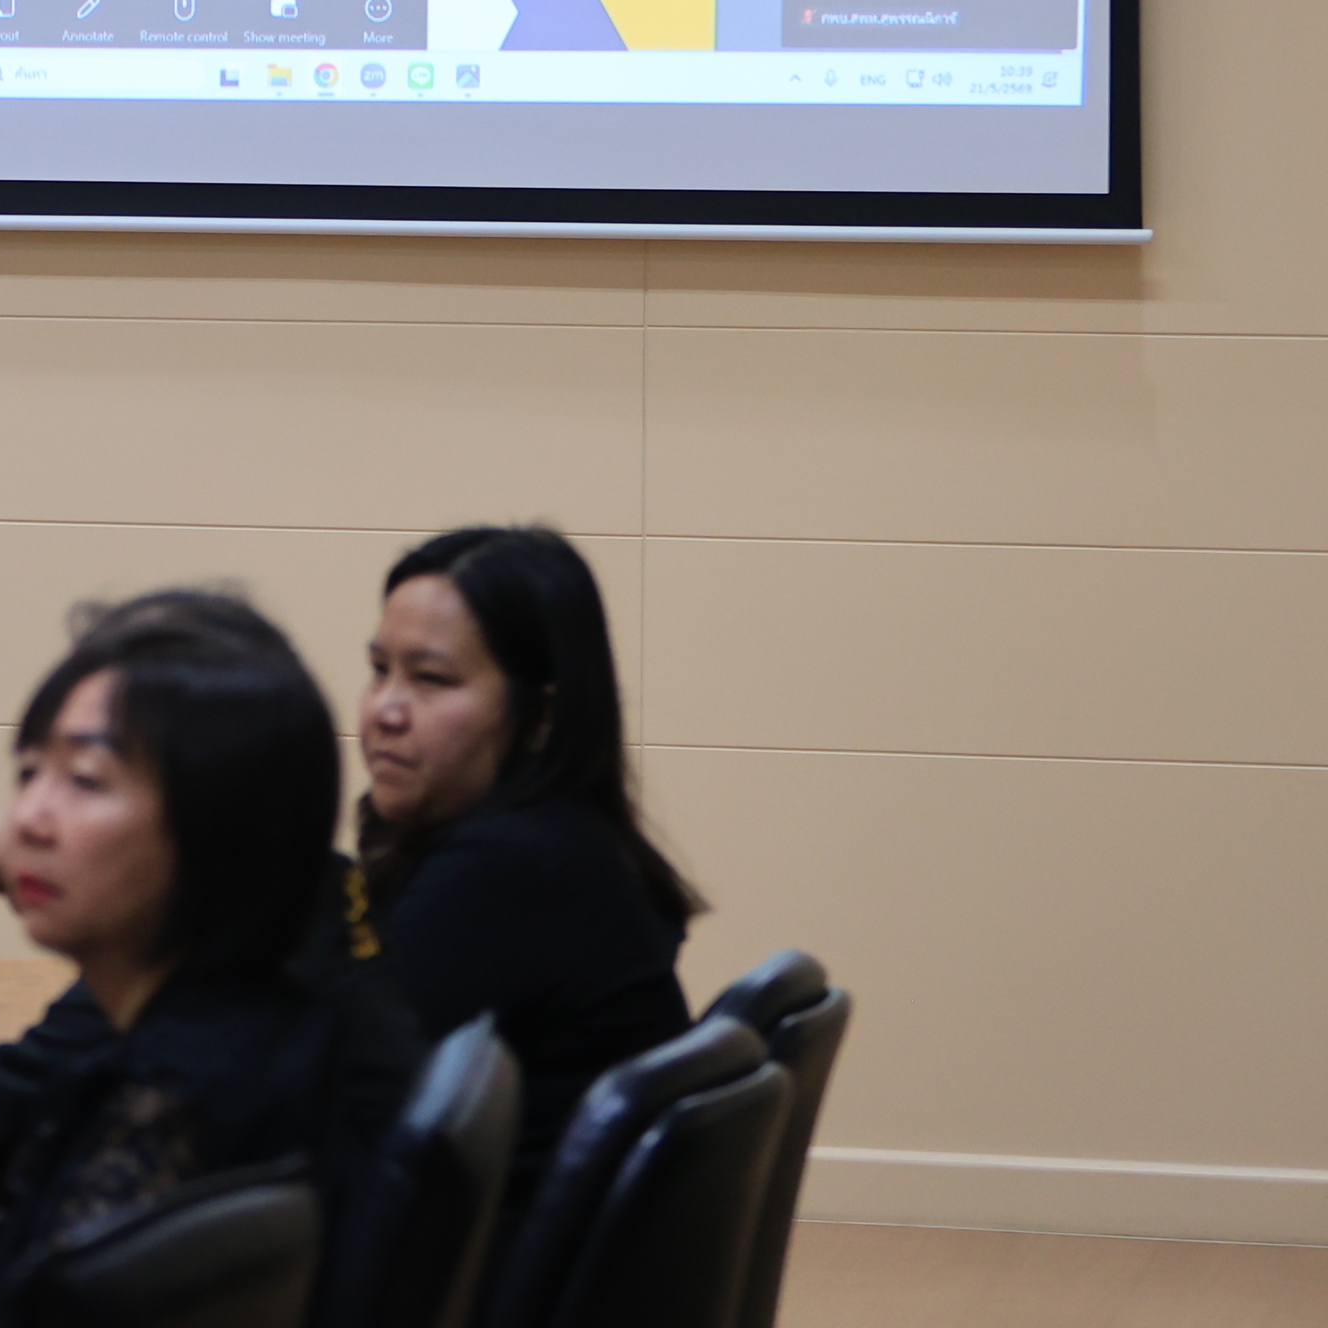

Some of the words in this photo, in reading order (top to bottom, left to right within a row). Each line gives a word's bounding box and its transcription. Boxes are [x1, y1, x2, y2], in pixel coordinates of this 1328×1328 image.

[62, 29, 115, 43] Annotate
[139, 30, 183, 43] Remote
[186, 30, 229, 44] control
[243, 31, 276, 44] Show
[278, 31, 326, 47] meeting
[363, 31, 394, 44] More
[999, 65, 1033, 78] 10:39
[859, 73, 887, 87] ENG
